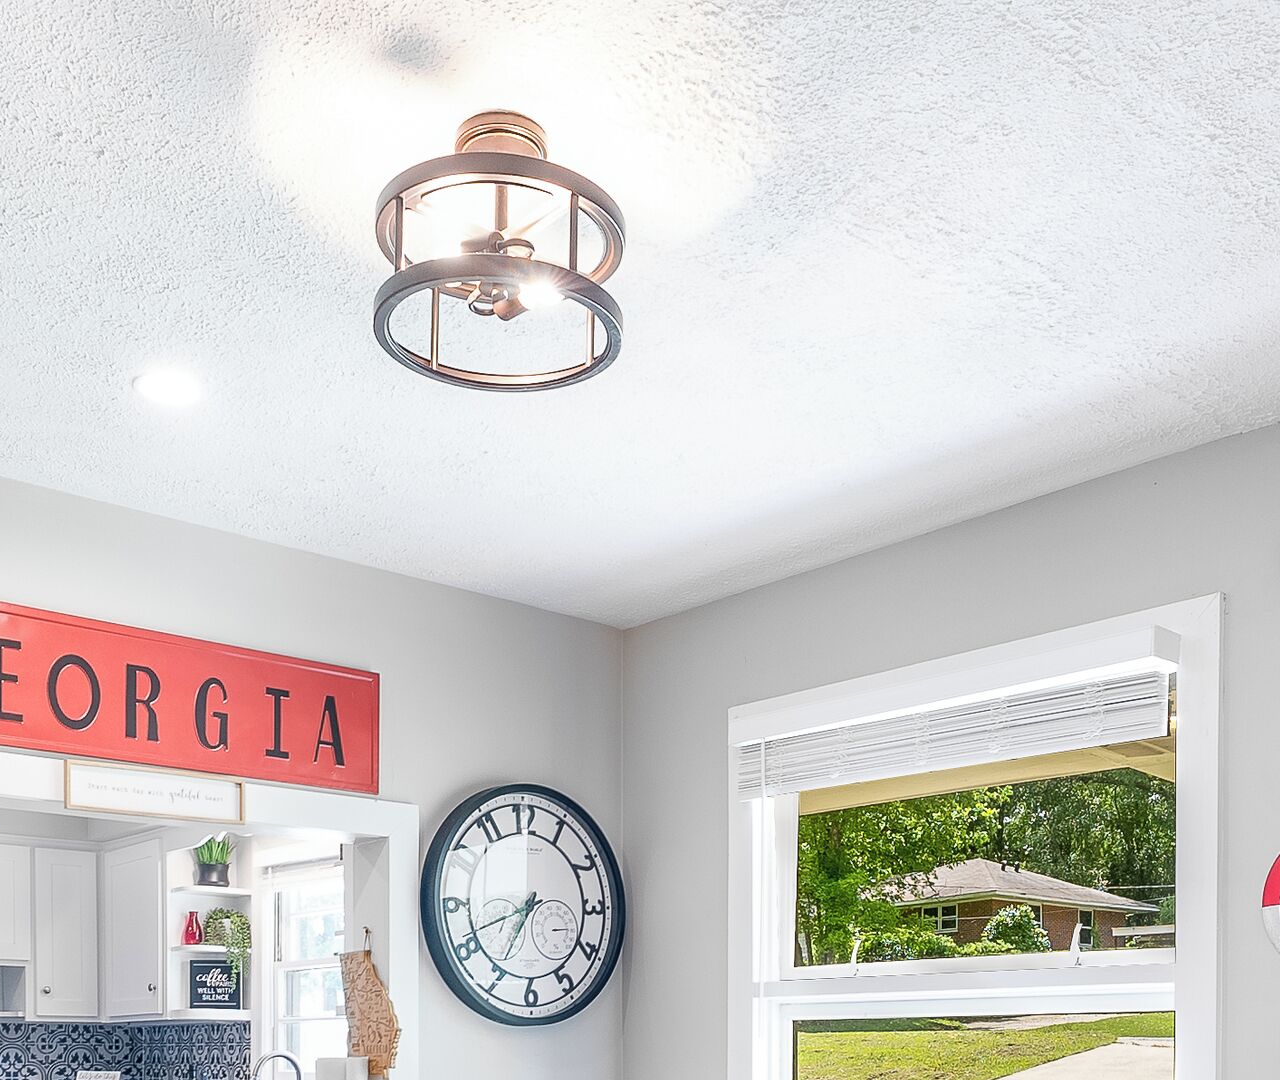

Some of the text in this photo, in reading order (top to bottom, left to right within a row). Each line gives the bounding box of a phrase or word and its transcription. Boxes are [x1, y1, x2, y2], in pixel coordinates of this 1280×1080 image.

[168, 787, 201, 804] grateful
[476, 812, 503, 843] 11
[512, 803, 537, 835] 12
[553, 819, 566, 845] 1
[573, 854, 596, 880] 2
[443, 896, 470, 913] 9
[584, 898, 605, 917] 3
[456, 936, 481, 961] 8
[578, 939, 598, 962] 4
[195, 968, 229, 987] coffee
[486, 964, 507, 993] 7
[554, 965, 576, 994] 5
[524, 978, 539, 1007] 6
